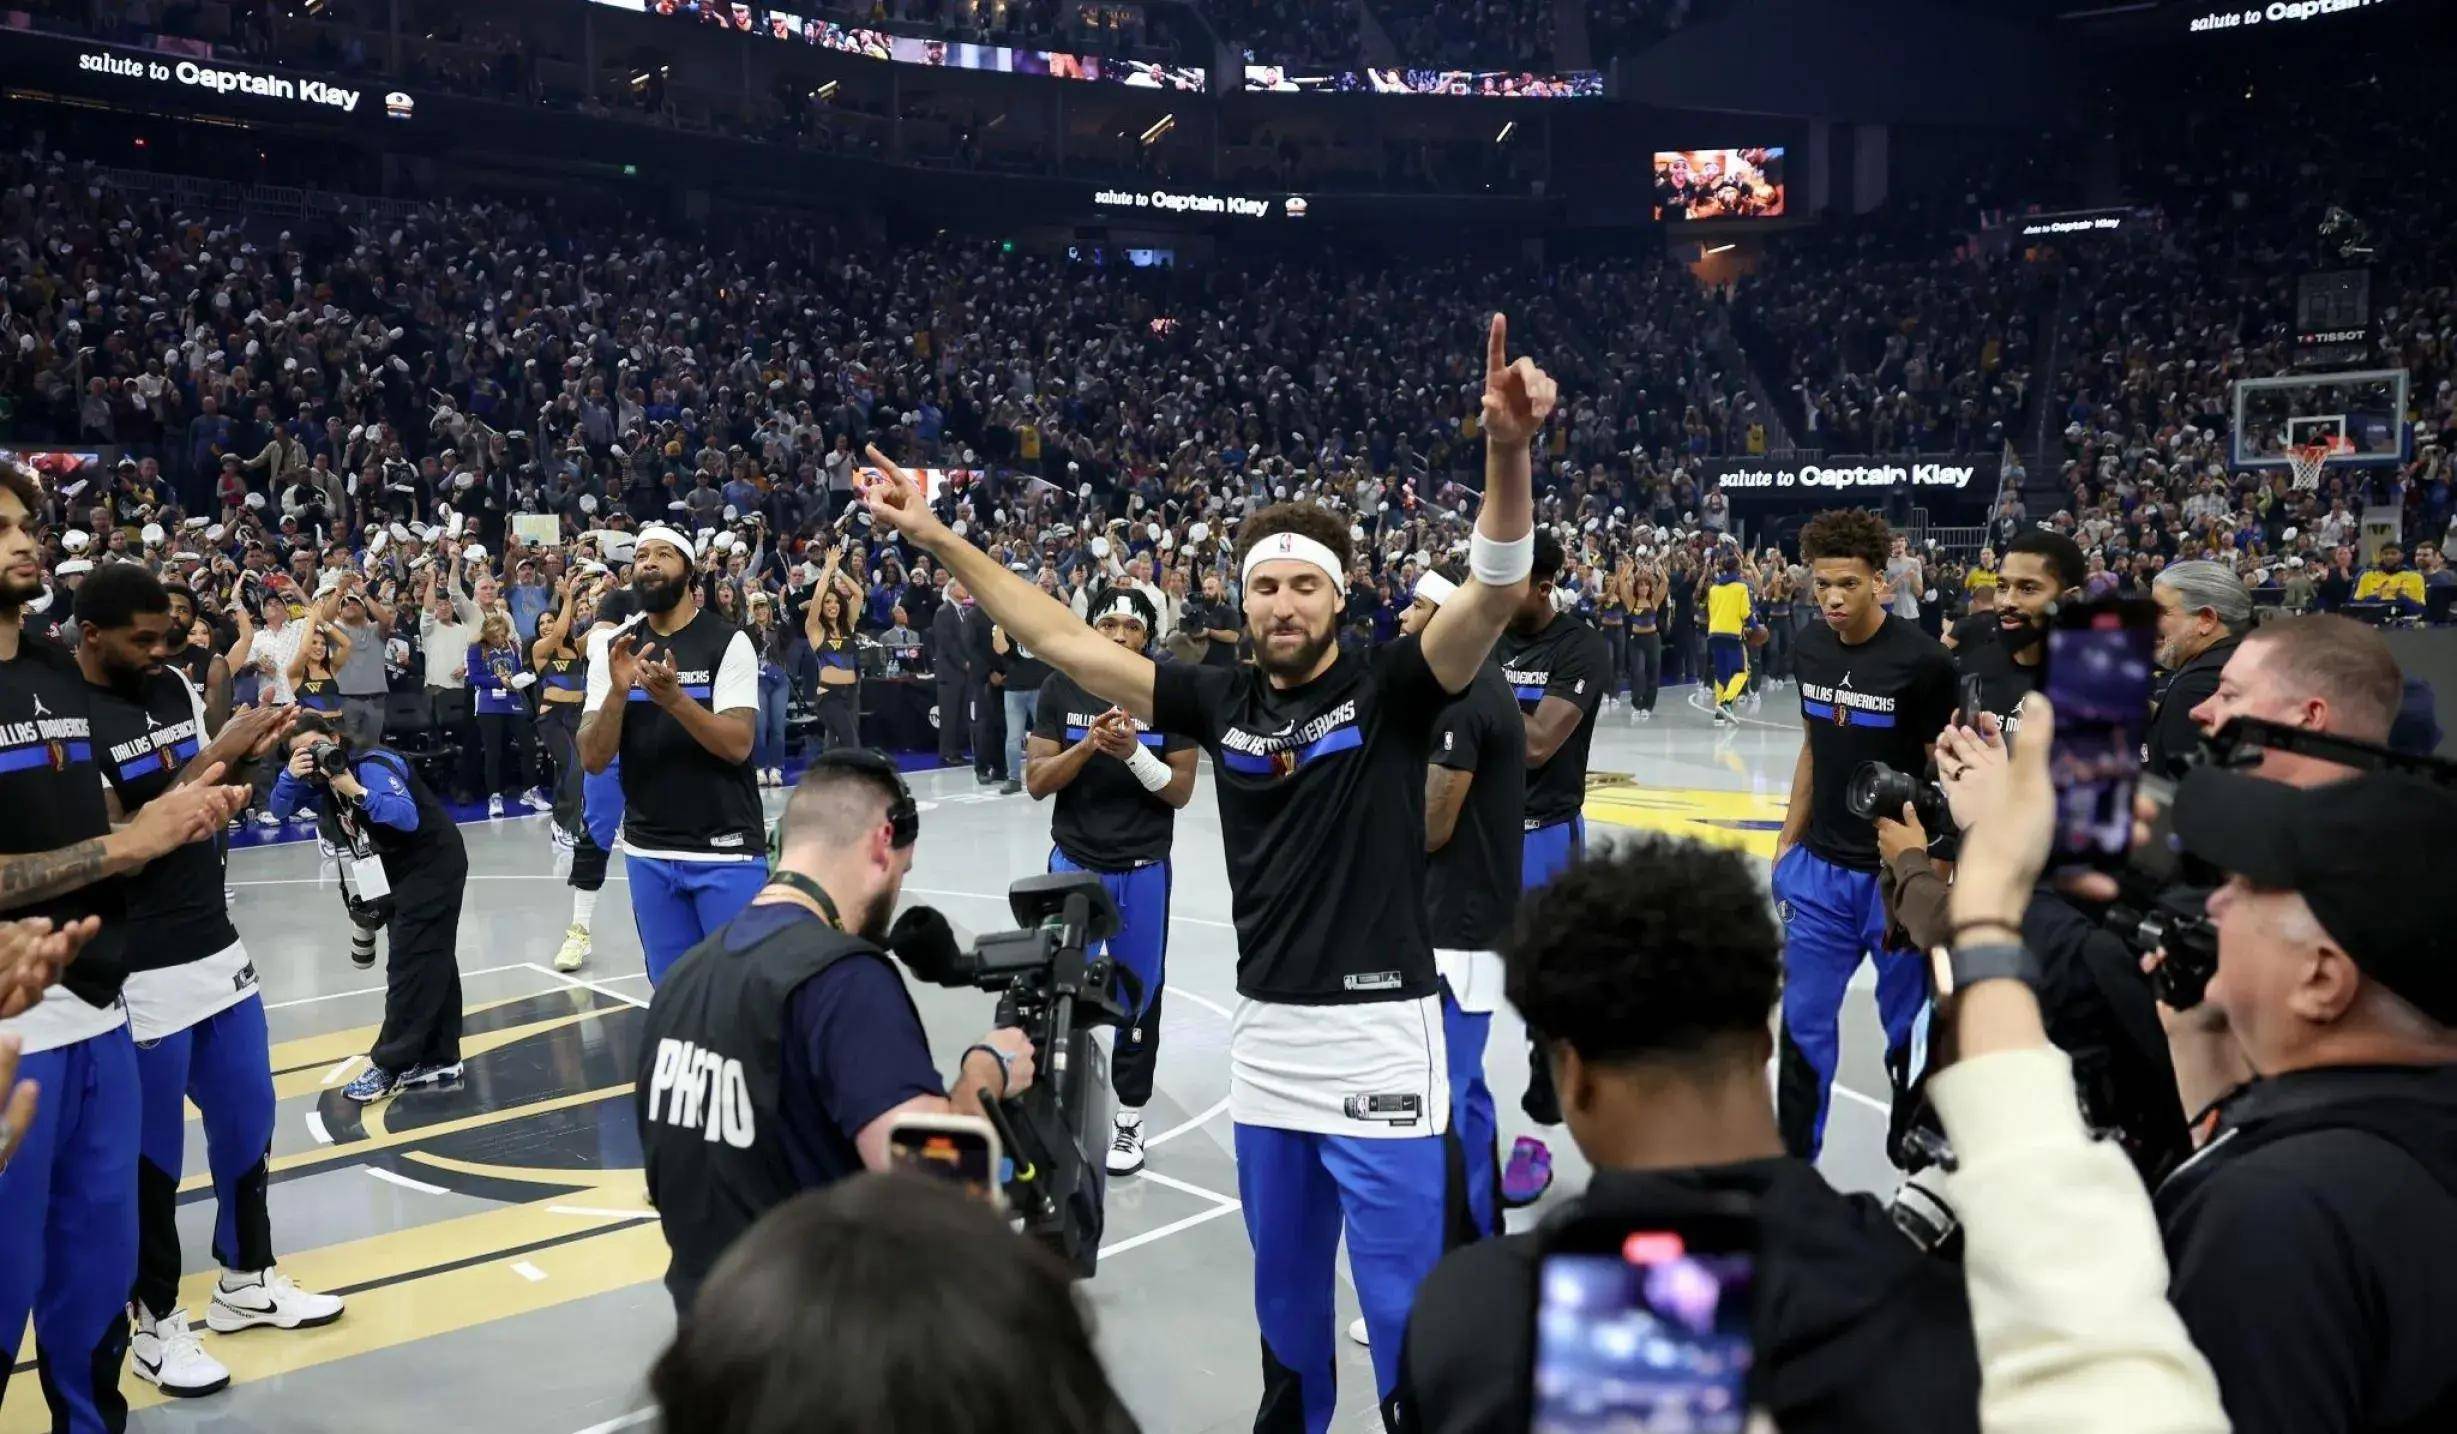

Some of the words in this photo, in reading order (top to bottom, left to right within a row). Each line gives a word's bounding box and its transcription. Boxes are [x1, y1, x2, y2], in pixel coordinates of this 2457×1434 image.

[2190, 13, 2240, 31] salute
[2244, 10, 2261, 24] to
[79, 53, 143, 77] salute
[149, 62, 169, 80] to
[176, 61, 294, 98] Captain
[300, 79, 359, 111] Klay
[1095, 190, 1133, 205] salute
[1136, 193, 1148, 206] to
[1152, 191, 1224, 212] Captain
[1227, 197, 1269, 217] Klay
[2315, 331, 2365, 342] TISSOT
[1719, 469, 1772, 487] salute
[1777, 470, 1795, 486] to
[1799, 465, 1906, 489] Captain
[1912, 464, 1974, 488] Klay
[676, 670, 710, 685] ERICKS
[1505, 668, 1549, 685] AVERICKS
[1803, 683, 1833, 702] DALLAS
[1834, 689, 1895, 711] MAVERICKS
[1066, 712, 1095, 727] DALLA
[110, 736, 152, 763] DALLAS
